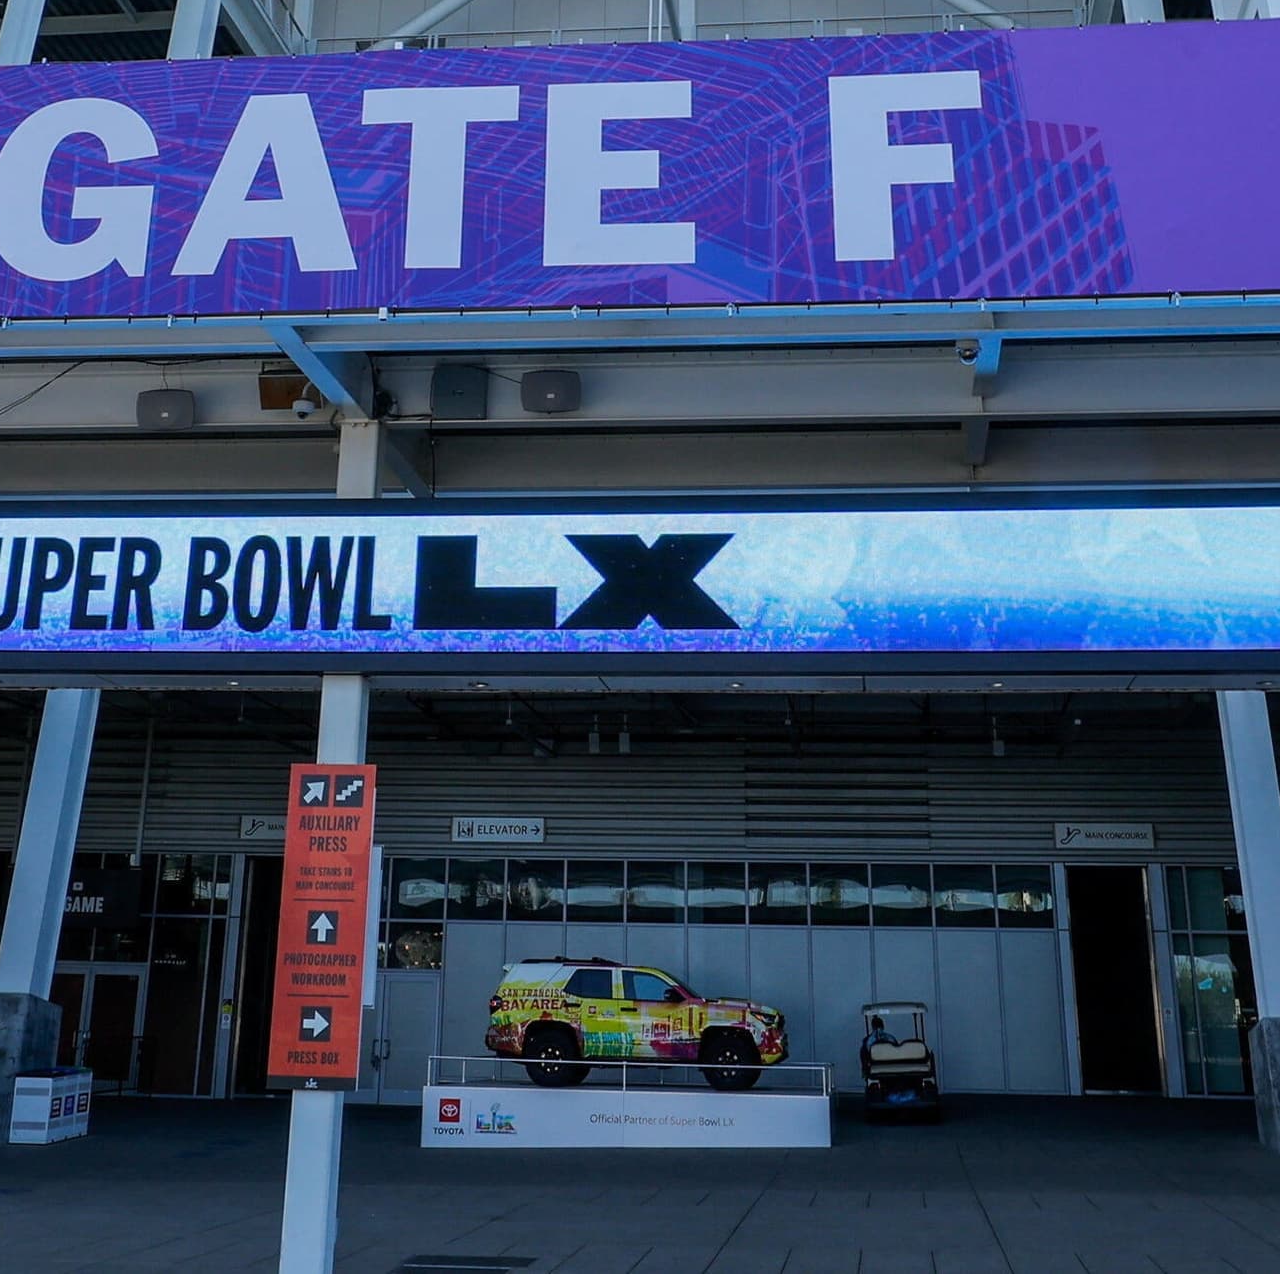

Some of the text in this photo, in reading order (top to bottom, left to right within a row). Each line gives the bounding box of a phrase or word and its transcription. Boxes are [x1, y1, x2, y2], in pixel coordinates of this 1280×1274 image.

[827, 69, 983, 262] F
[182, 534, 393, 631] BOWL
[413, 533, 743, 630] LX
[299, 814, 361, 832] AUXILIARY
[477, 825, 528, 835] ELEVATOR
[309, 836, 348, 852] PRESS
[283, 953, 357, 967] PHOTOGRAPHER
[291, 973, 347, 986] WORKROOM
[500, 999, 569, 1012] BAY AREA
[287, 1051, 340, 1065] PRESS BOX
[589, 1113, 735, 1128] Official Partner of Super Bowl LX
[433, 1127, 465, 1136] TOYOTA
